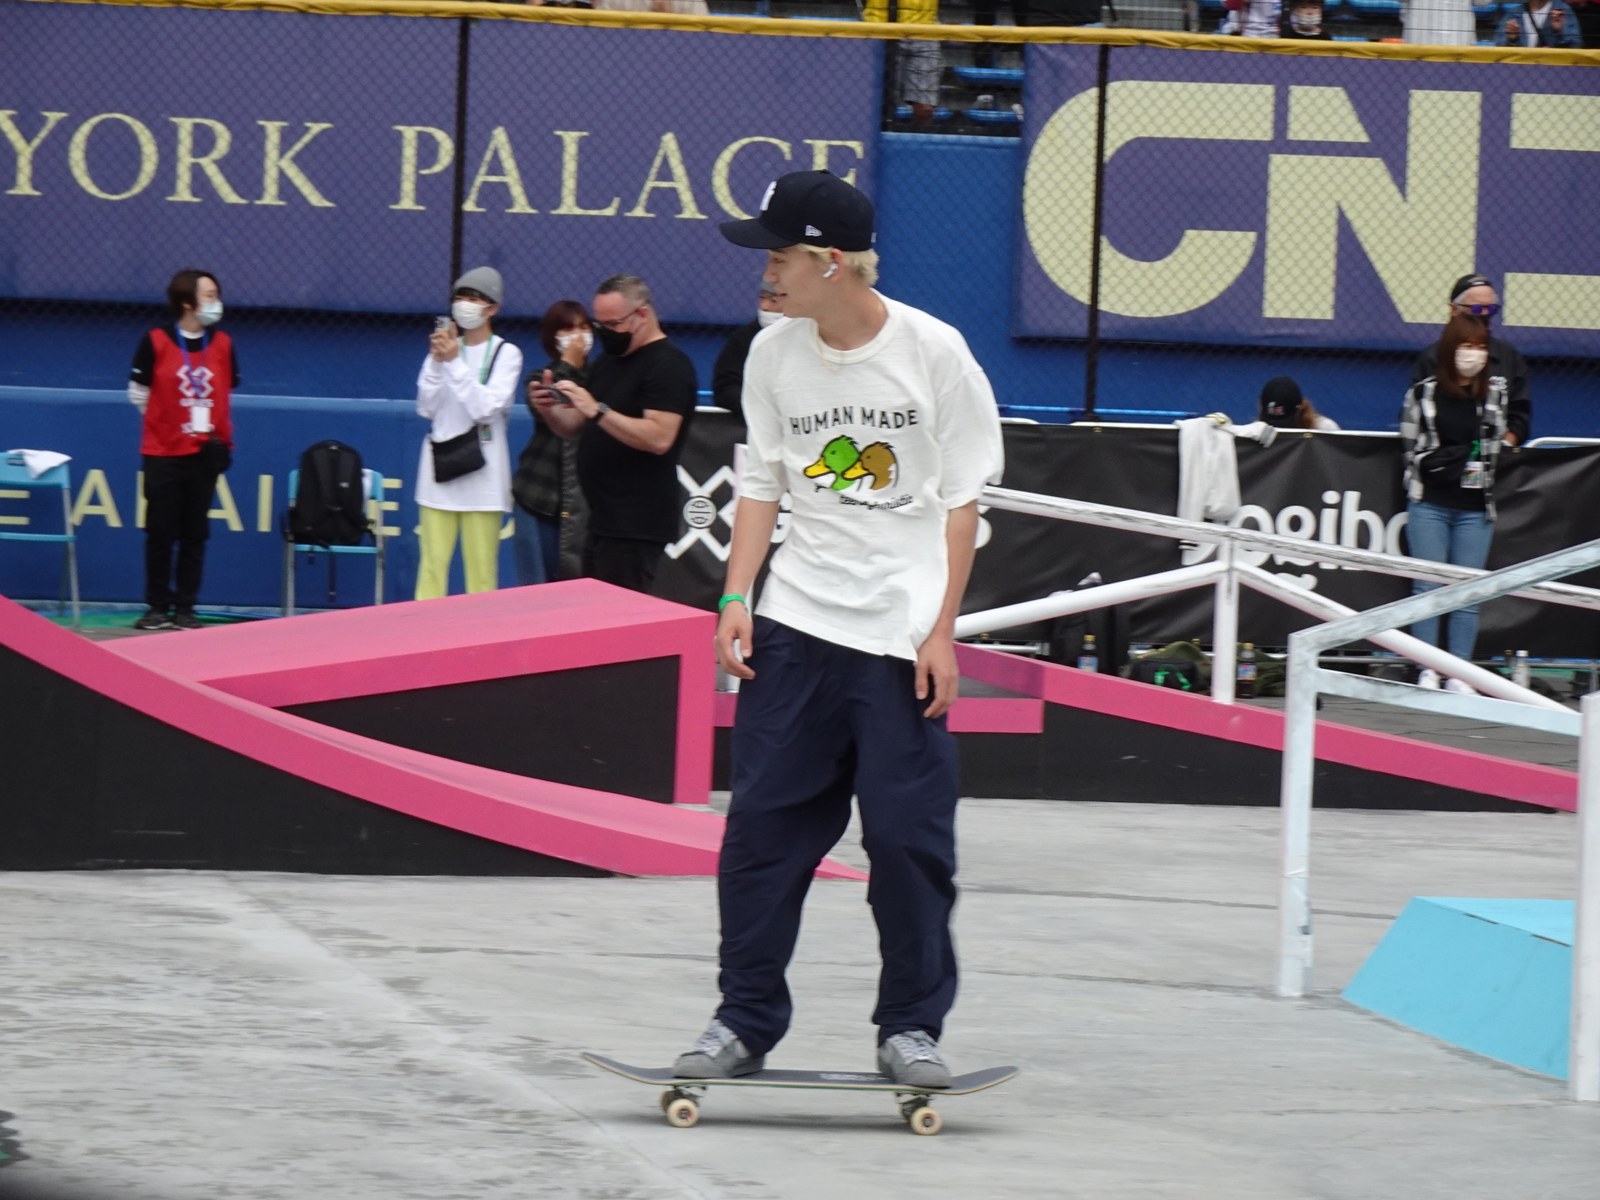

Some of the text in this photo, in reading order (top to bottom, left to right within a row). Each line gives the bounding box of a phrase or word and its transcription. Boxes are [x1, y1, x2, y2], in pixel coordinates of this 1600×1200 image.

[0, 110, 336, 208] YORK
[789, 405, 919, 435] HUMAN MADE
